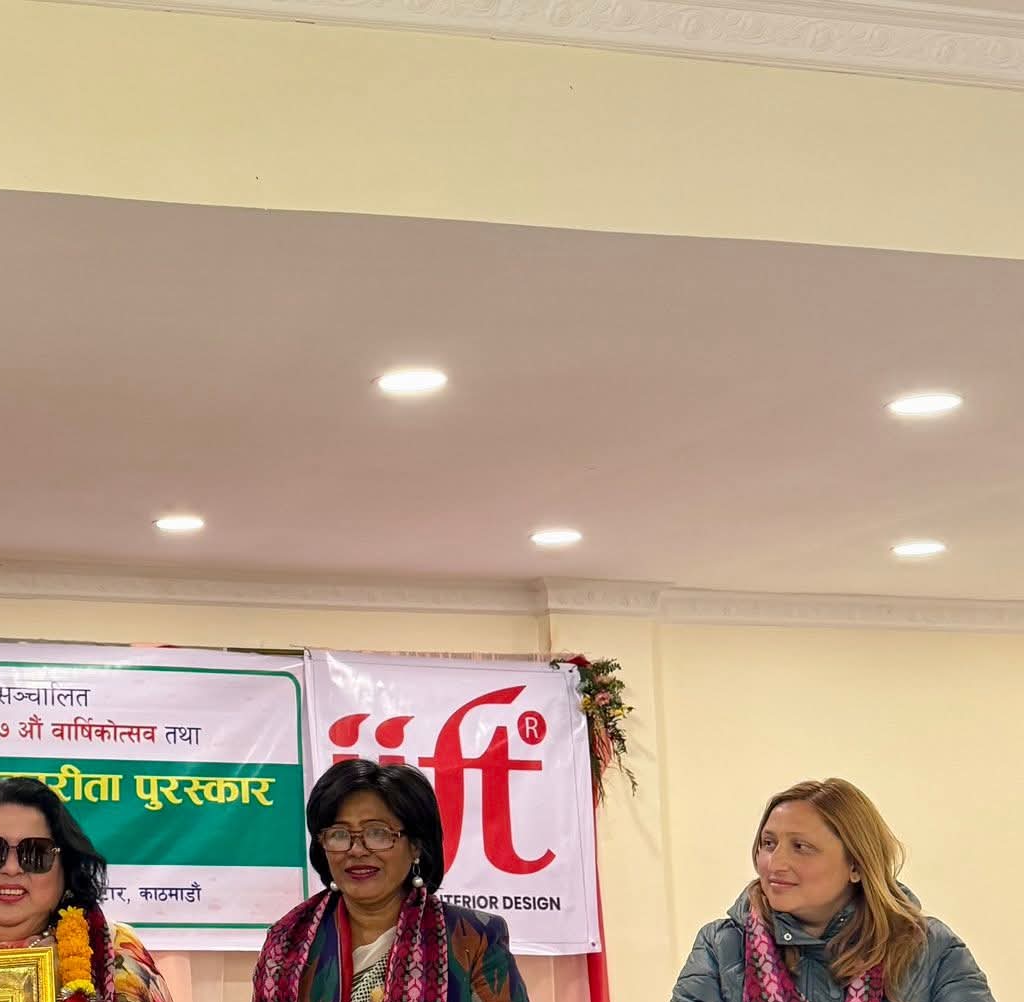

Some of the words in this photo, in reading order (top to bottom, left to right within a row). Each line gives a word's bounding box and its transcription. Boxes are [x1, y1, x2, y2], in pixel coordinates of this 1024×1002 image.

[51, 716, 158, 743] वार्षिकोत्सव
[165, 727, 202, 746] तथा
[134, 773, 276, 810] पुरस्कार
[503, 896, 561, 910] DESIGN
